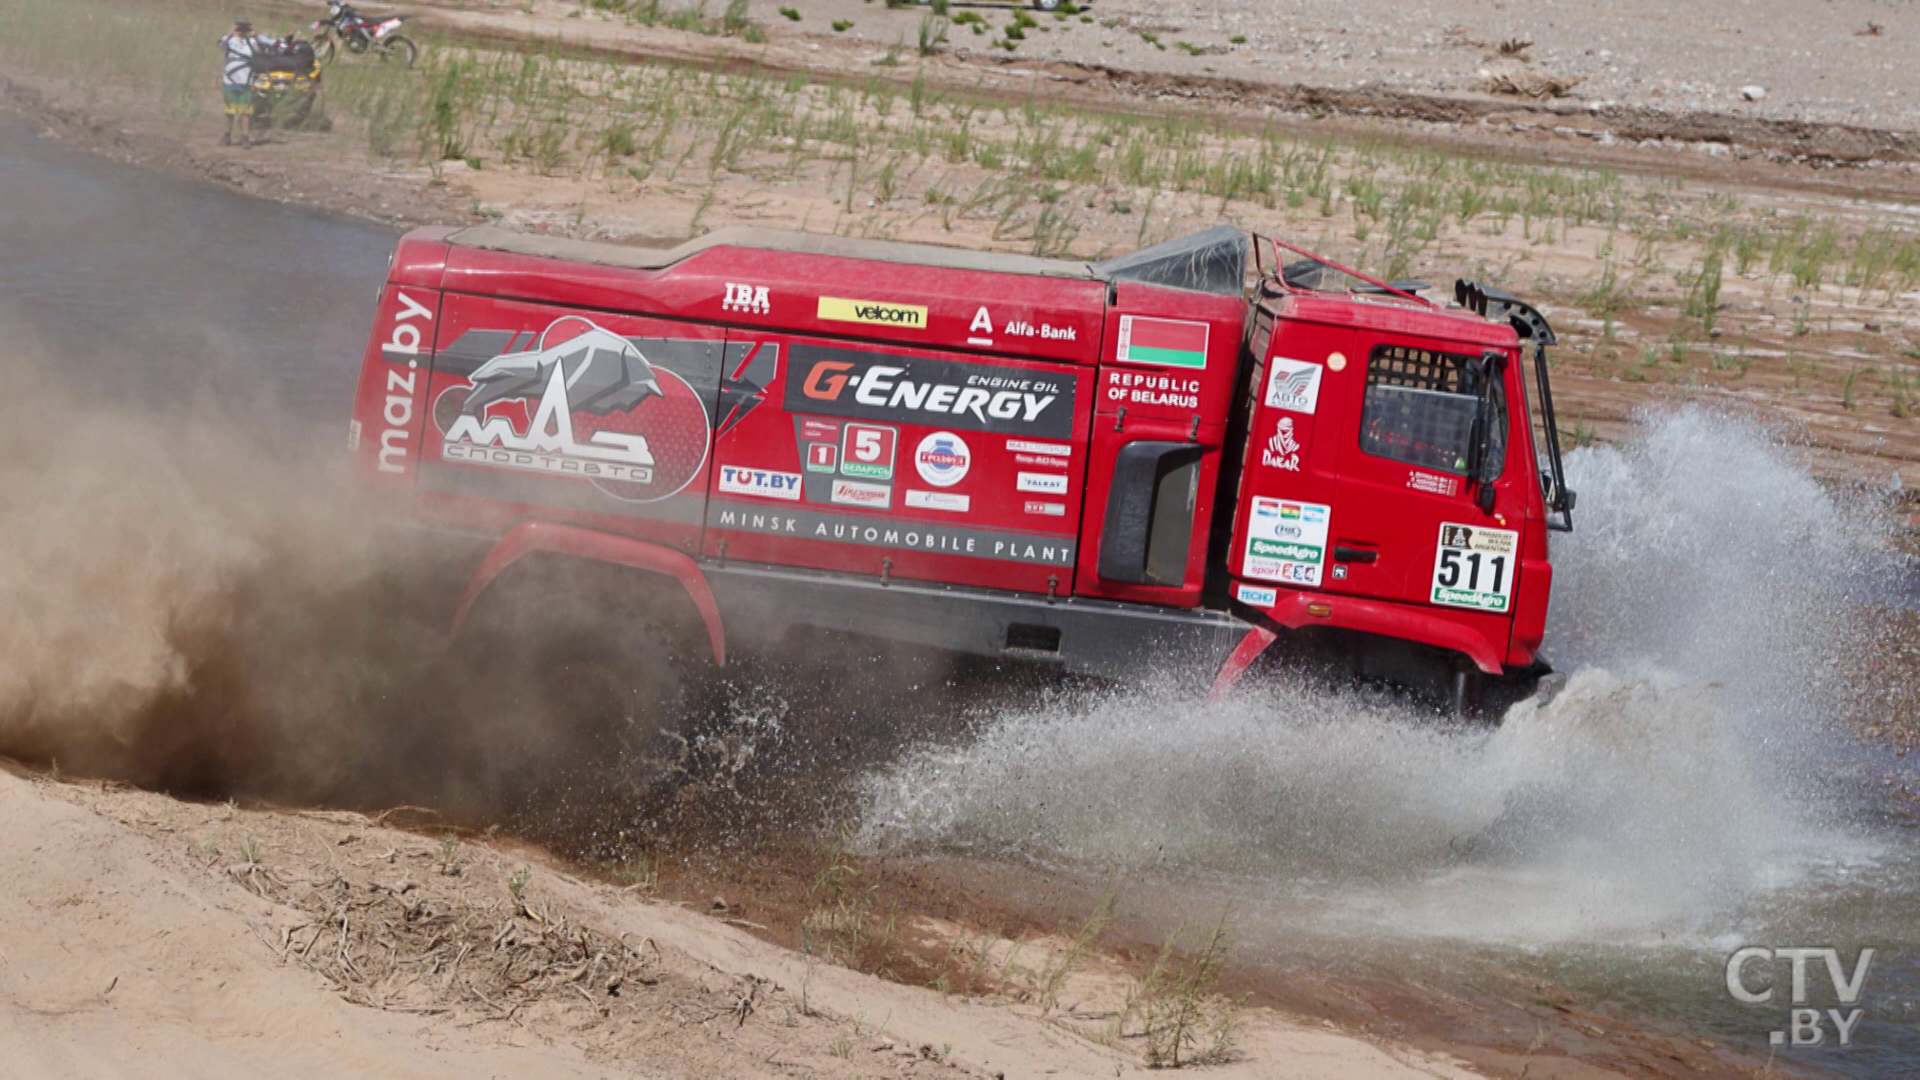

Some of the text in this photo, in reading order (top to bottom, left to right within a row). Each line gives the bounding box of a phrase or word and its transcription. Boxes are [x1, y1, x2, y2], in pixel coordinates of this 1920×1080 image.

[722, 281, 770, 309] IBA
[854, 304, 920, 325] velcom
[377, 290, 434, 474] maz.by
[966, 375, 1060, 394] ENGINE OIL
[1109, 372, 1200, 393] REPUBLIC
[1107, 389, 1199, 408] OF BELARUS
[816, 446, 829, 464] 1
[854, 429, 882, 462] 5
[723, 468, 799, 491] TUT.BY
[843, 463, 890, 475] БЕЛАРУСЬ
[720, 509, 1072, 563] MINSK AUTOMOBILE PLANT
[1252, 540, 1320, 560] SpeedAgro
[1438, 549, 1506, 594] 511
[1437, 588, 1504, 608] SpeedAgro
